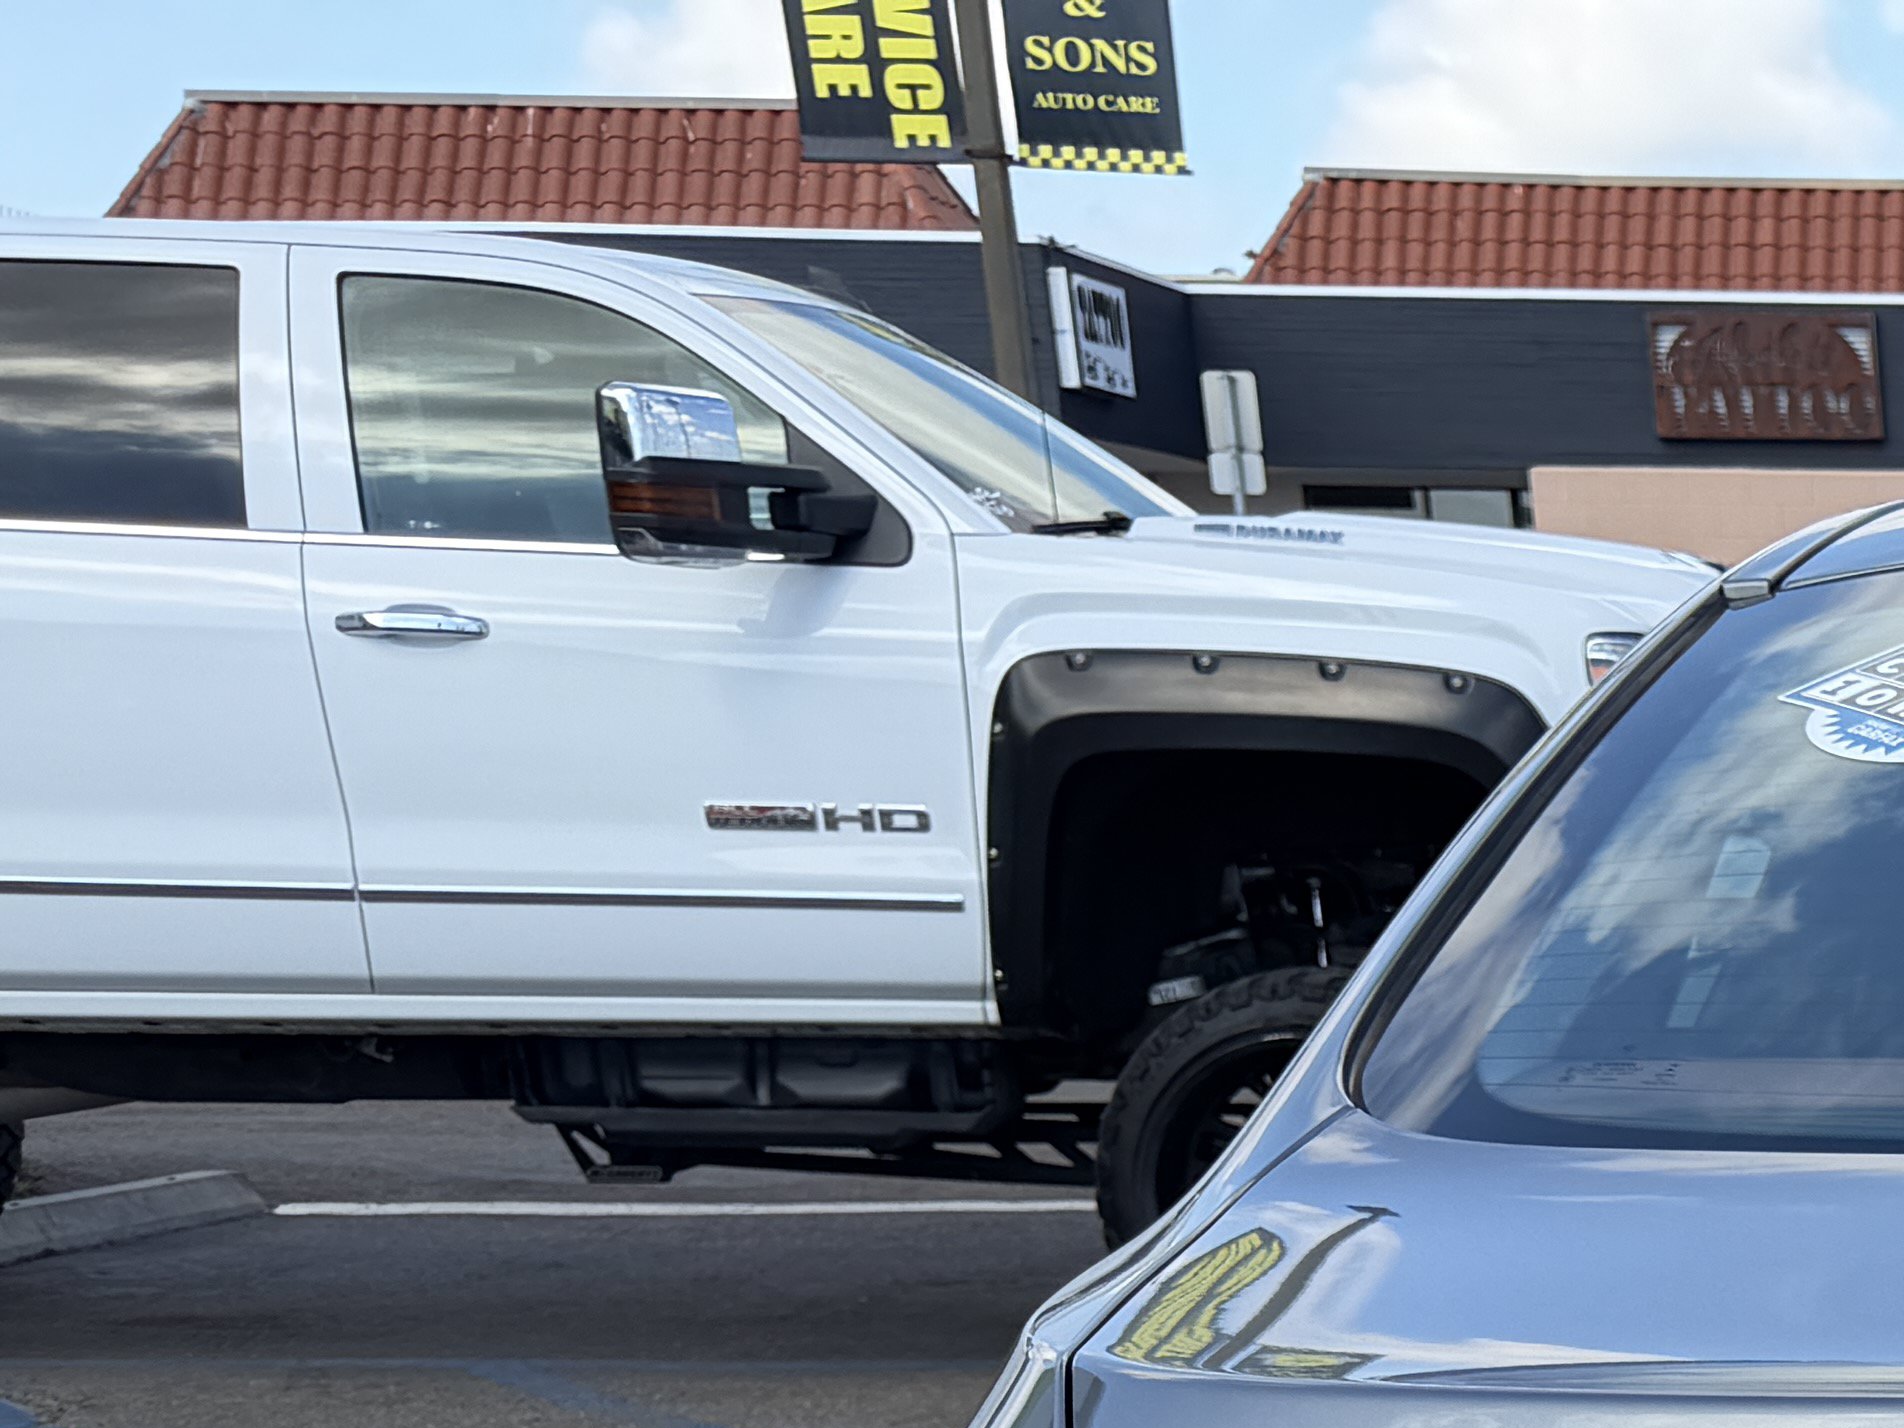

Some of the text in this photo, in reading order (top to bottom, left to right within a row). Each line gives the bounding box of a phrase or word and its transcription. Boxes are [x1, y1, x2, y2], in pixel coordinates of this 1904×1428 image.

[1023, 34, 1158, 77] SONS
[1032, 91, 1161, 114] AUTO CARE
[1817, 679, 1863, 699] 1
[820, 802, 932, 833] HD
